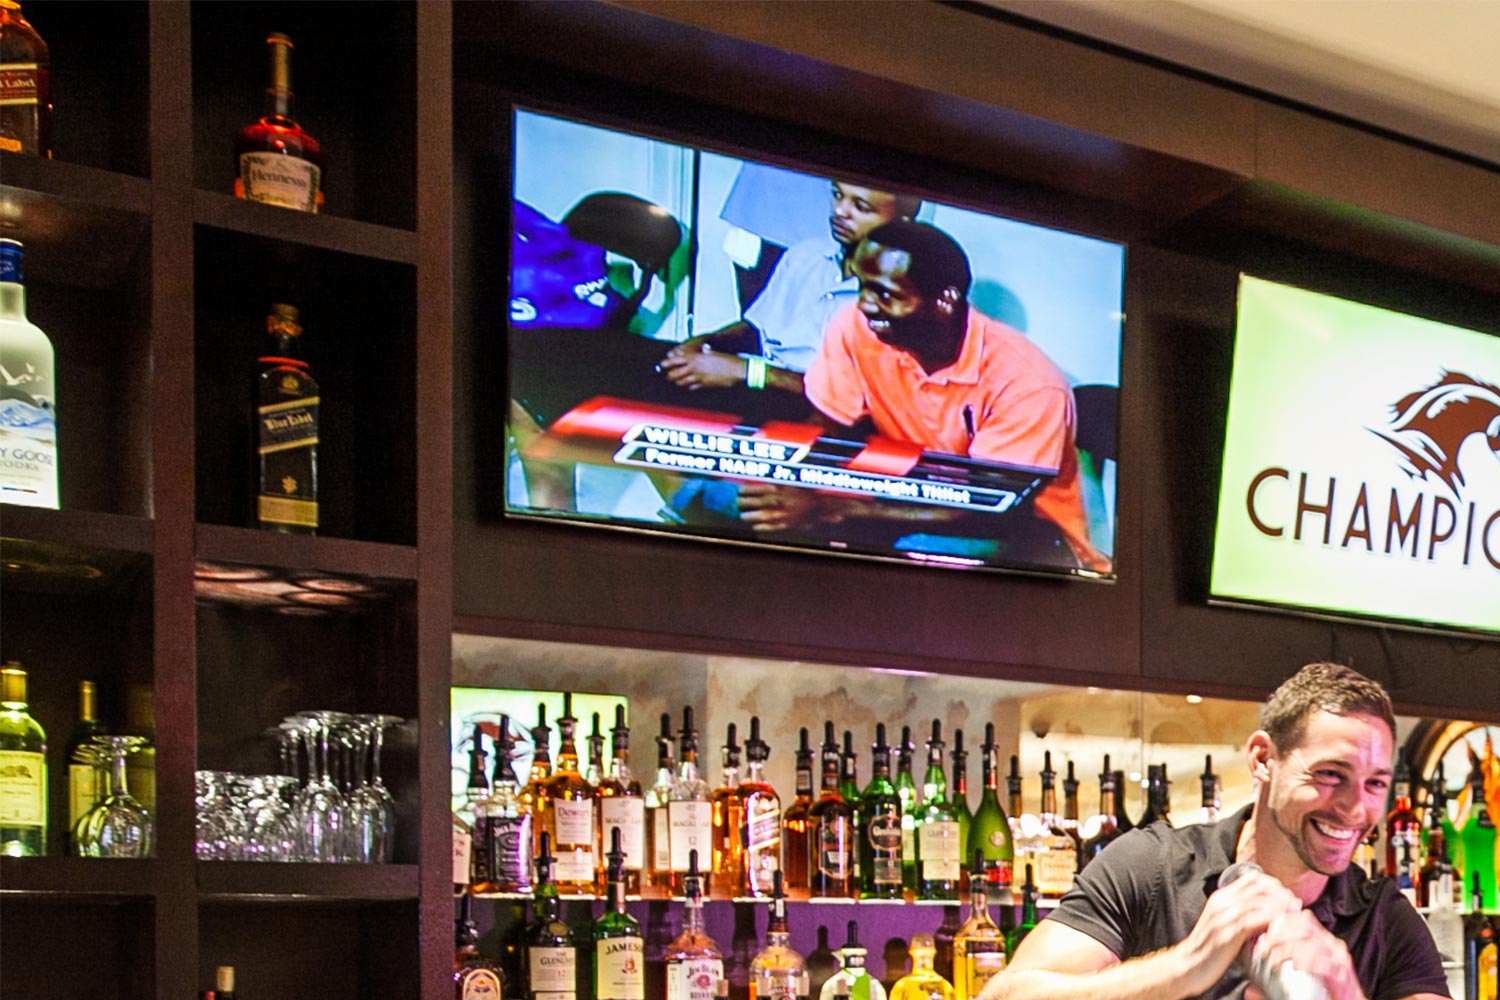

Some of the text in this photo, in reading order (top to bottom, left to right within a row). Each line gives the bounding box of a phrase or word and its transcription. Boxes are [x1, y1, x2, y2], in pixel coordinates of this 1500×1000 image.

[644, 426, 787, 460] WILLIE LEE
[645, 448, 717, 472] Former
[772, 465, 796, 482] Jr.
[800, 468, 919, 497] Middleweight
